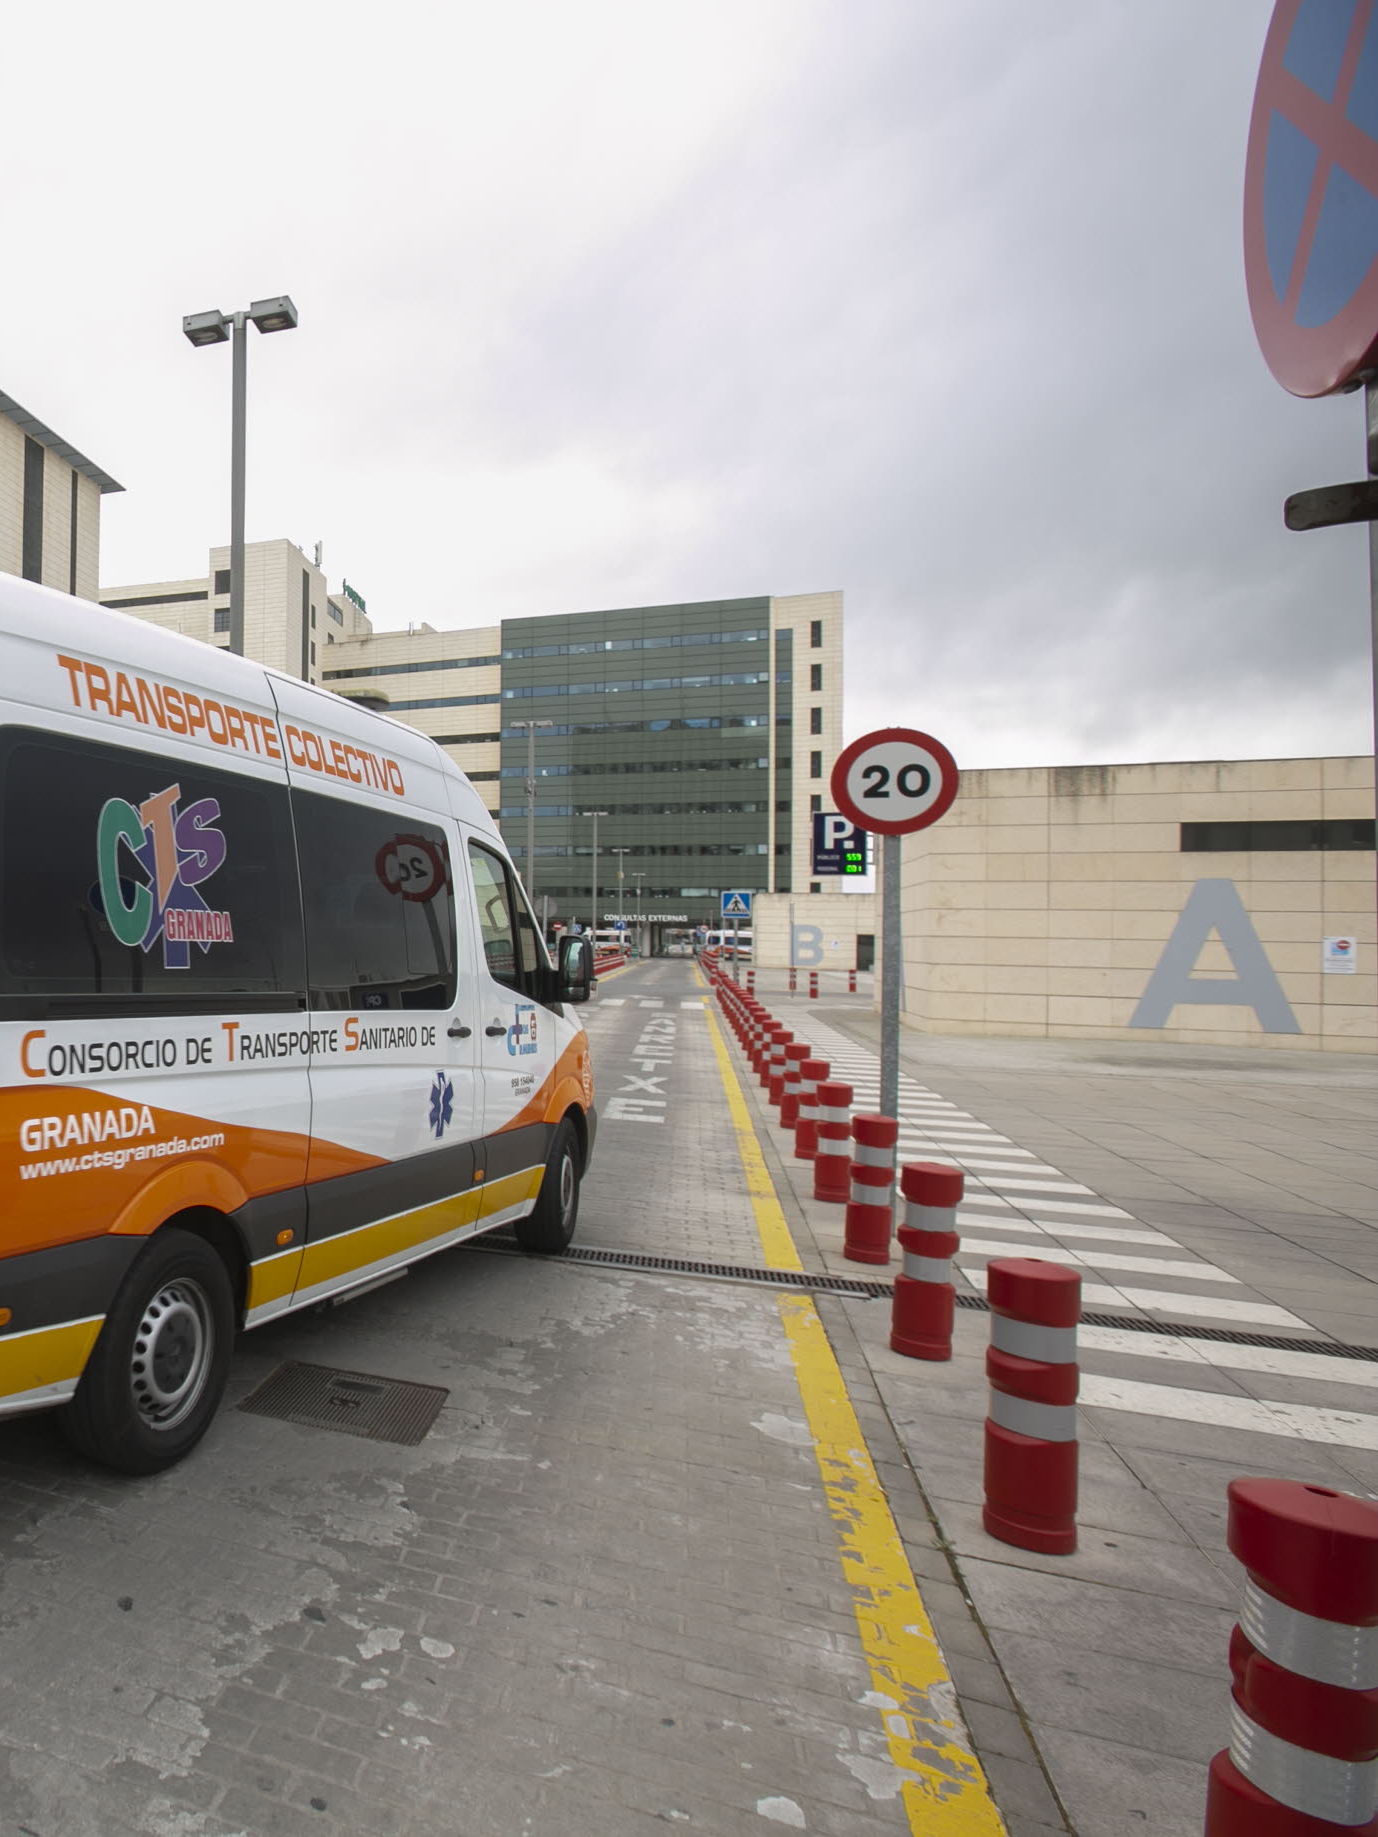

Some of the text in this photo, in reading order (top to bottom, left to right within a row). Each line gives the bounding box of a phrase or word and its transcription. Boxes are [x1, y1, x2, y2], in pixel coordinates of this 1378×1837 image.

[57, 654, 405, 796] TRANSPORTE COLECTIVO
[862, 763, 931, 798] 20
[165, 908, 234, 942] GRANADA
[648, 914, 688, 922] EXTERNAS
[791, 925, 824, 966] B
[1129, 878, 1304, 1034] A
[20, 1017, 436, 1078] CONSORCIO DE TRANSPORTE SANITARIO DE
[20, 1106, 156, 1152] GRANADA
[19, 1133, 225, 1180] www.ctsgranada.com
